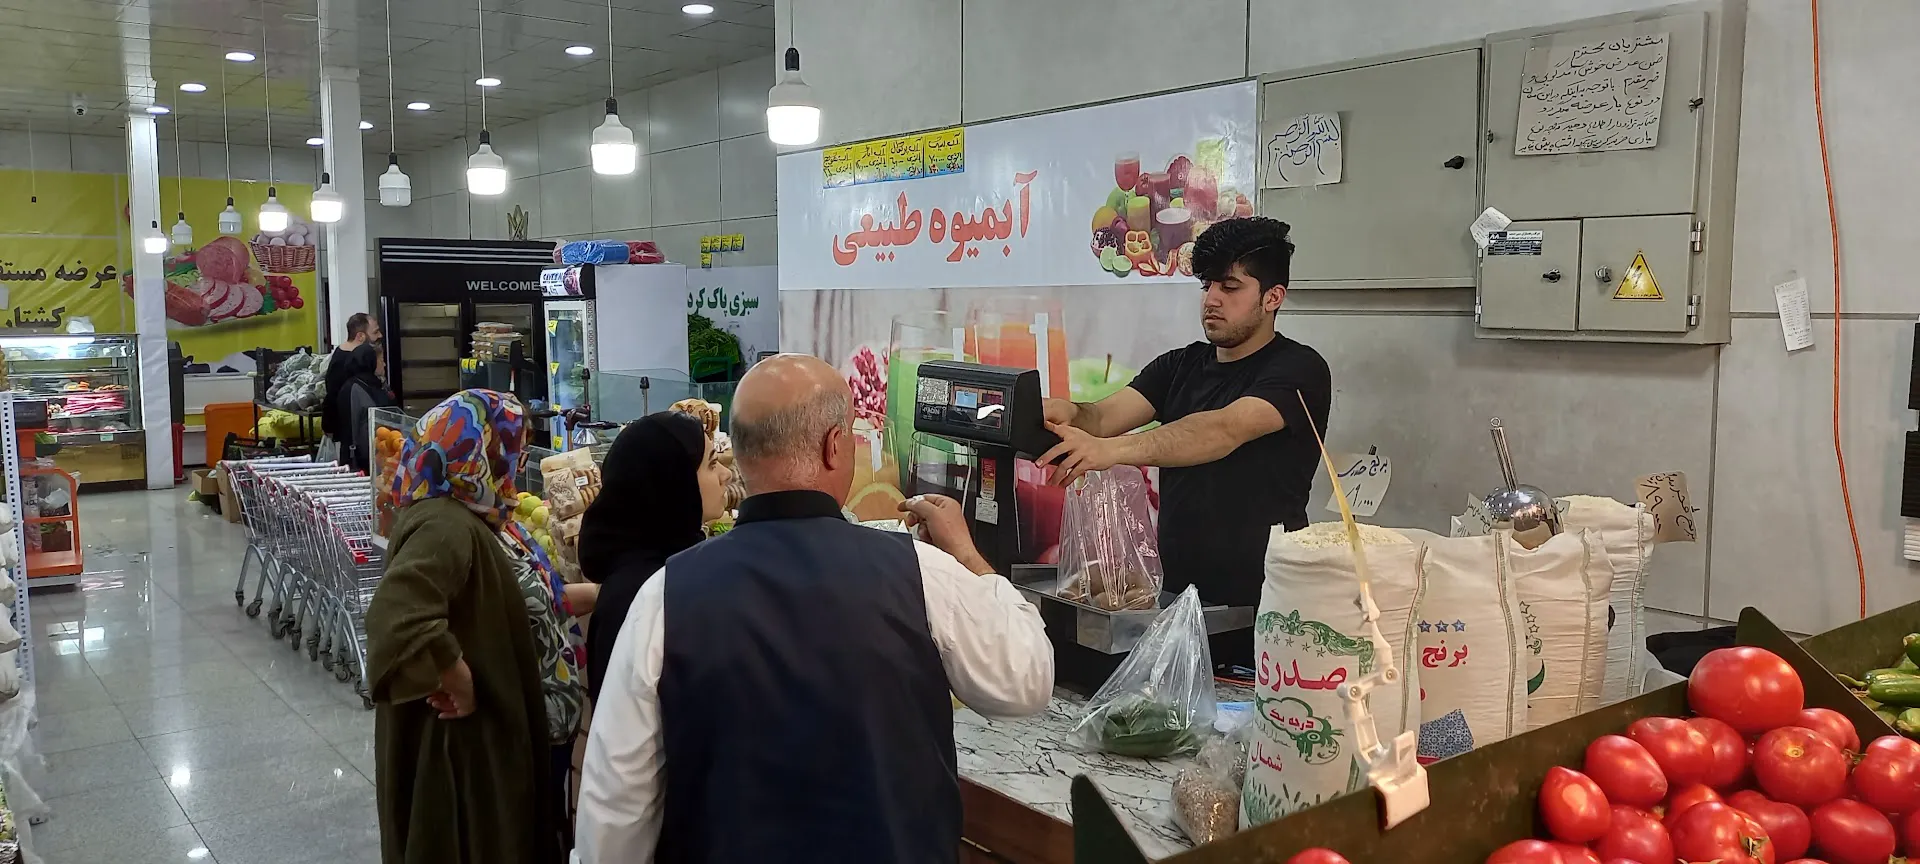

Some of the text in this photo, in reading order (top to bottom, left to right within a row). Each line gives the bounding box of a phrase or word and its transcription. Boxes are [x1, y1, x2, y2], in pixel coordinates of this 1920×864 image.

[832, 170, 1039, 266] آبمیوه طبیعی
[54, 260, 117, 289] عرضه
[465, 280, 540, 291] WELCOME
[687, 286, 759, 317] سبزی پاک کرد
[1421, 639, 1469, 668] برنج
[1257, 651, 1347, 692] صدری
[1269, 708, 1315, 731] درجه یک
[1251, 741, 1283, 772] شمال
